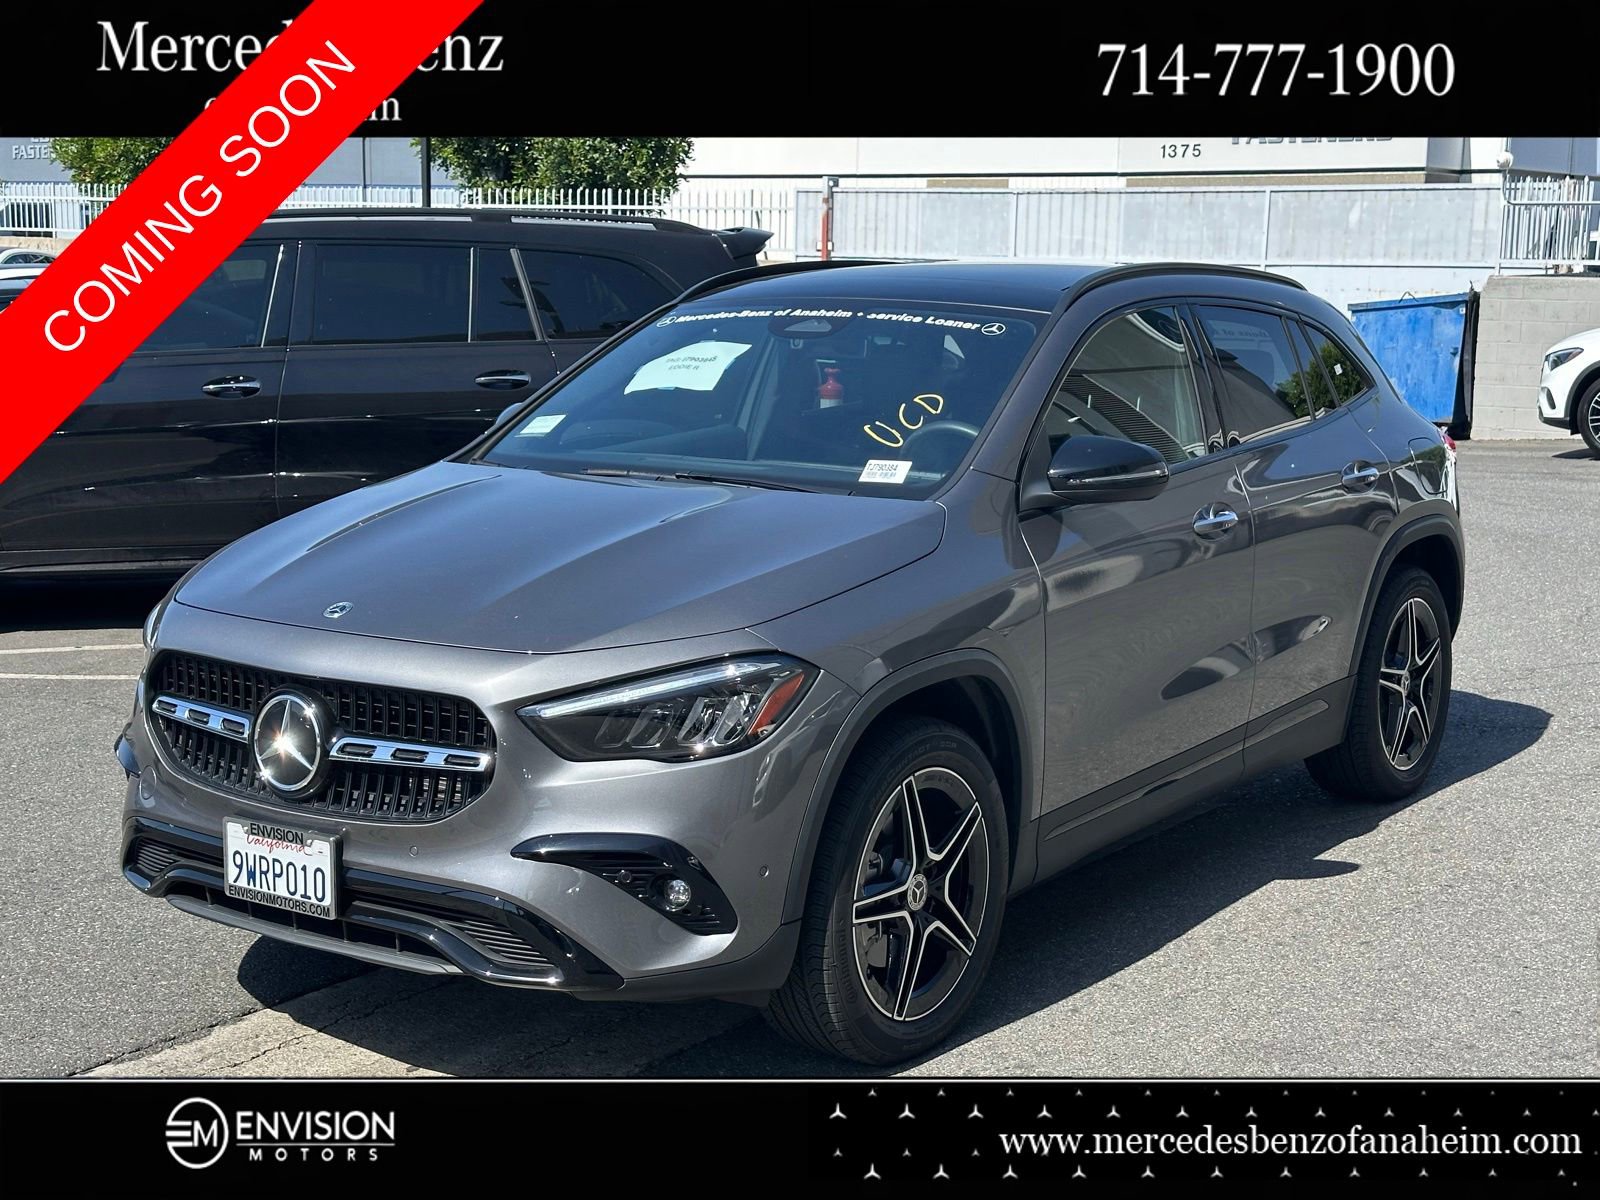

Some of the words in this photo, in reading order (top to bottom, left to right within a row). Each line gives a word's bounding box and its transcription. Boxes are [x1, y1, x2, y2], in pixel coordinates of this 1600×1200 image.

[12, 144, 50, 160] FASTE
[1159, 143, 1202, 159] 1375
[674, 309, 771, 323] Mercedes-Benz
[774, 308, 791, 317] of
[792, 308, 853, 318] Anaheim
[924, 316, 981, 330] Loaner
[250, 822, 304, 845] ENVISION
[232, 849, 326, 903] 9WRP010
[228, 884, 331, 918] ENVISIONMOTORS.COM
